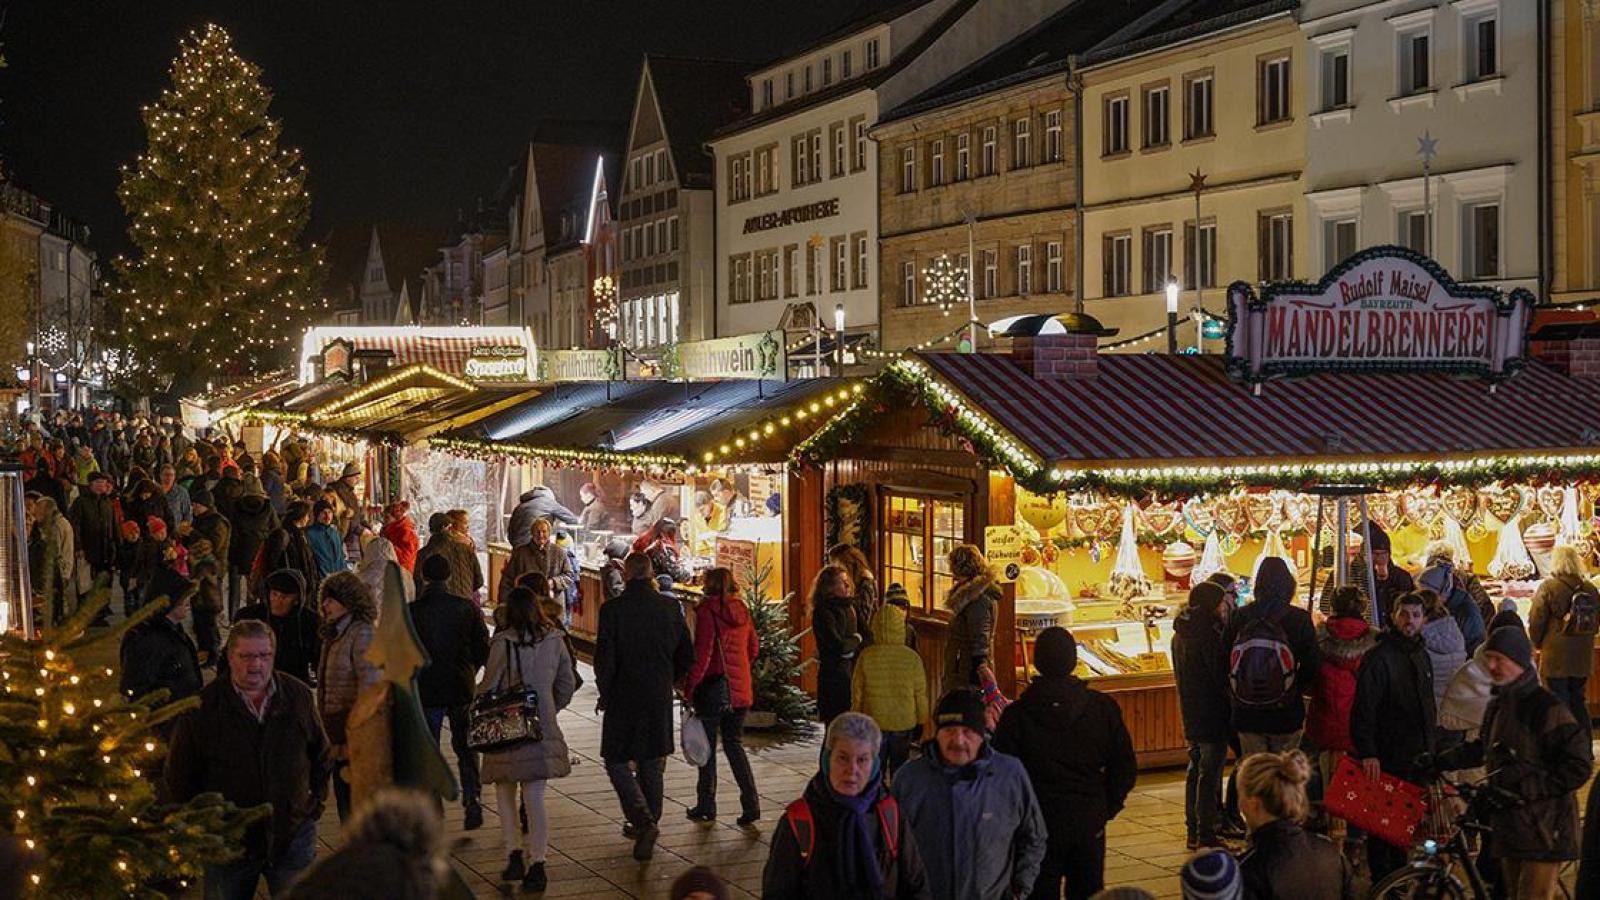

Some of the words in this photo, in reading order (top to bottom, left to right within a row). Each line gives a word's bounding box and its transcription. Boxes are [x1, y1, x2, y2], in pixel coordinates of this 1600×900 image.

[743, 198, 839, 234] ADLER-APOTHEKE
[1340, 270, 1383, 305] Rudolf
[1390, 270, 1433, 303] Maisel
[1361, 300, 1413, 308] BAYREUTH
[1266, 307, 1494, 358] MANDELBRENNEREI
